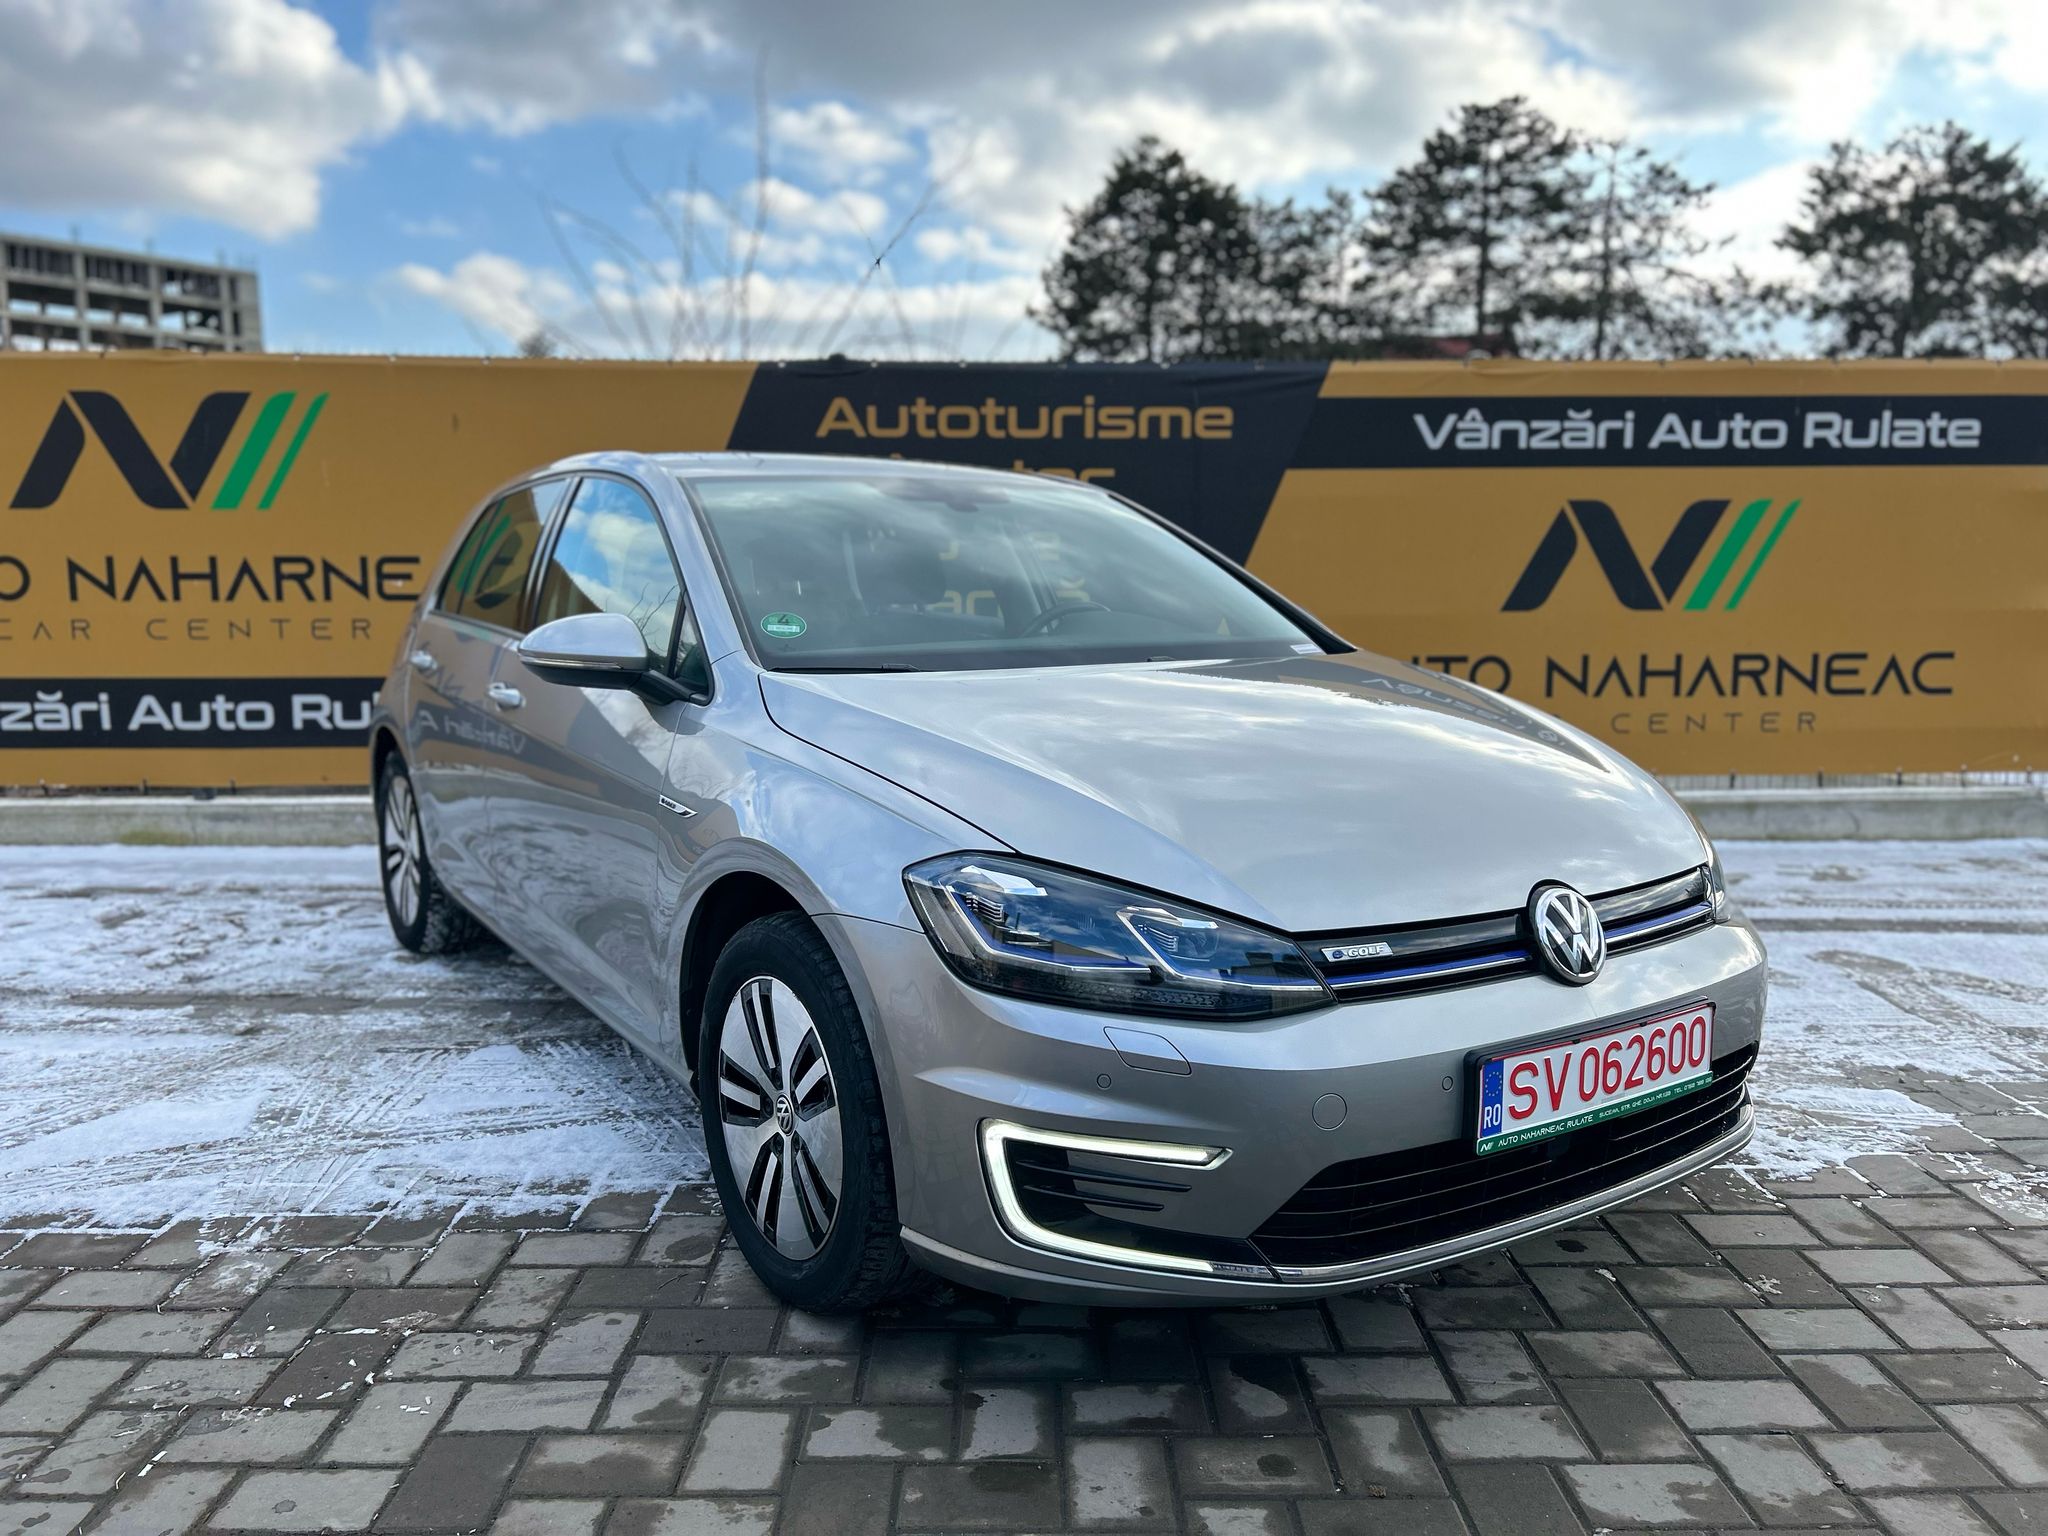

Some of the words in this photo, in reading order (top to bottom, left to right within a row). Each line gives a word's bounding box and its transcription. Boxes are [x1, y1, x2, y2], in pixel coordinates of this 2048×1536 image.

[817, 396, 1234, 439] Autoturisme
[1413, 408, 1636, 450] Vânzări
[1648, 412, 1789, 449] Auto
[1803, 410, 1983, 449] Rulate
[67, 556, 421, 602] NAHARNE
[145, 618, 372, 641] CENTER
[1545, 652, 1955, 698] NAHARNEAC
[0, 690, 112, 731] zări
[128, 694, 275, 731] Auto
[1611, 711, 1817, 735] CENTER
[1483, 1103, 1501, 1130] RO
[1498, 1135, 1518, 1147] AUTO
[1520, 1122, 1565, 1141] NAHARNEAC
[1566, 1114, 1594, 1129] RULATE
